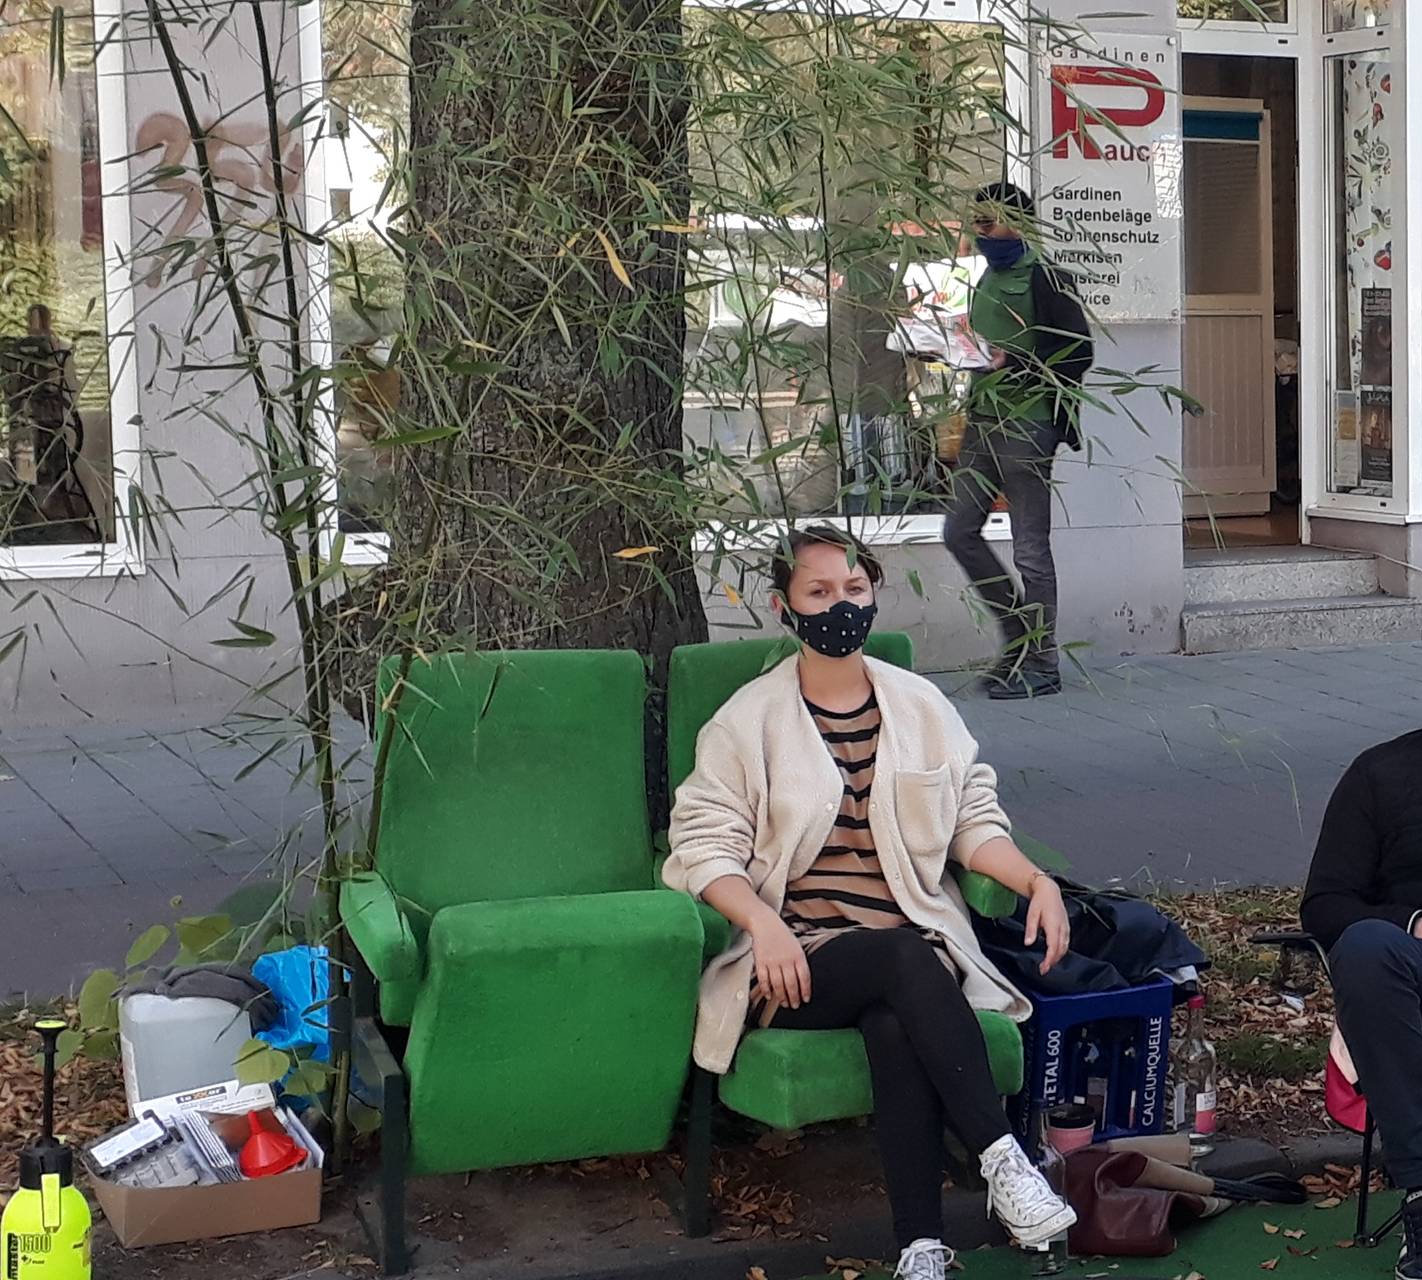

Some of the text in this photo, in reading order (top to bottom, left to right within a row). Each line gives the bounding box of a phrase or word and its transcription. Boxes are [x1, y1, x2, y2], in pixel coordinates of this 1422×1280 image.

[1051, 64, 1166, 162] Rauc
[1052, 186, 1122, 201] Gardinen
[1053, 207, 1152, 226] Bodenbeläge
[1053, 229, 1160, 244] Sonnenschutz
[1046, 1029, 1062, 1056] 600
[1142, 1016, 1163, 1127] CALCIUMQUELLE
[20, 1232, 52, 1254] 1500
